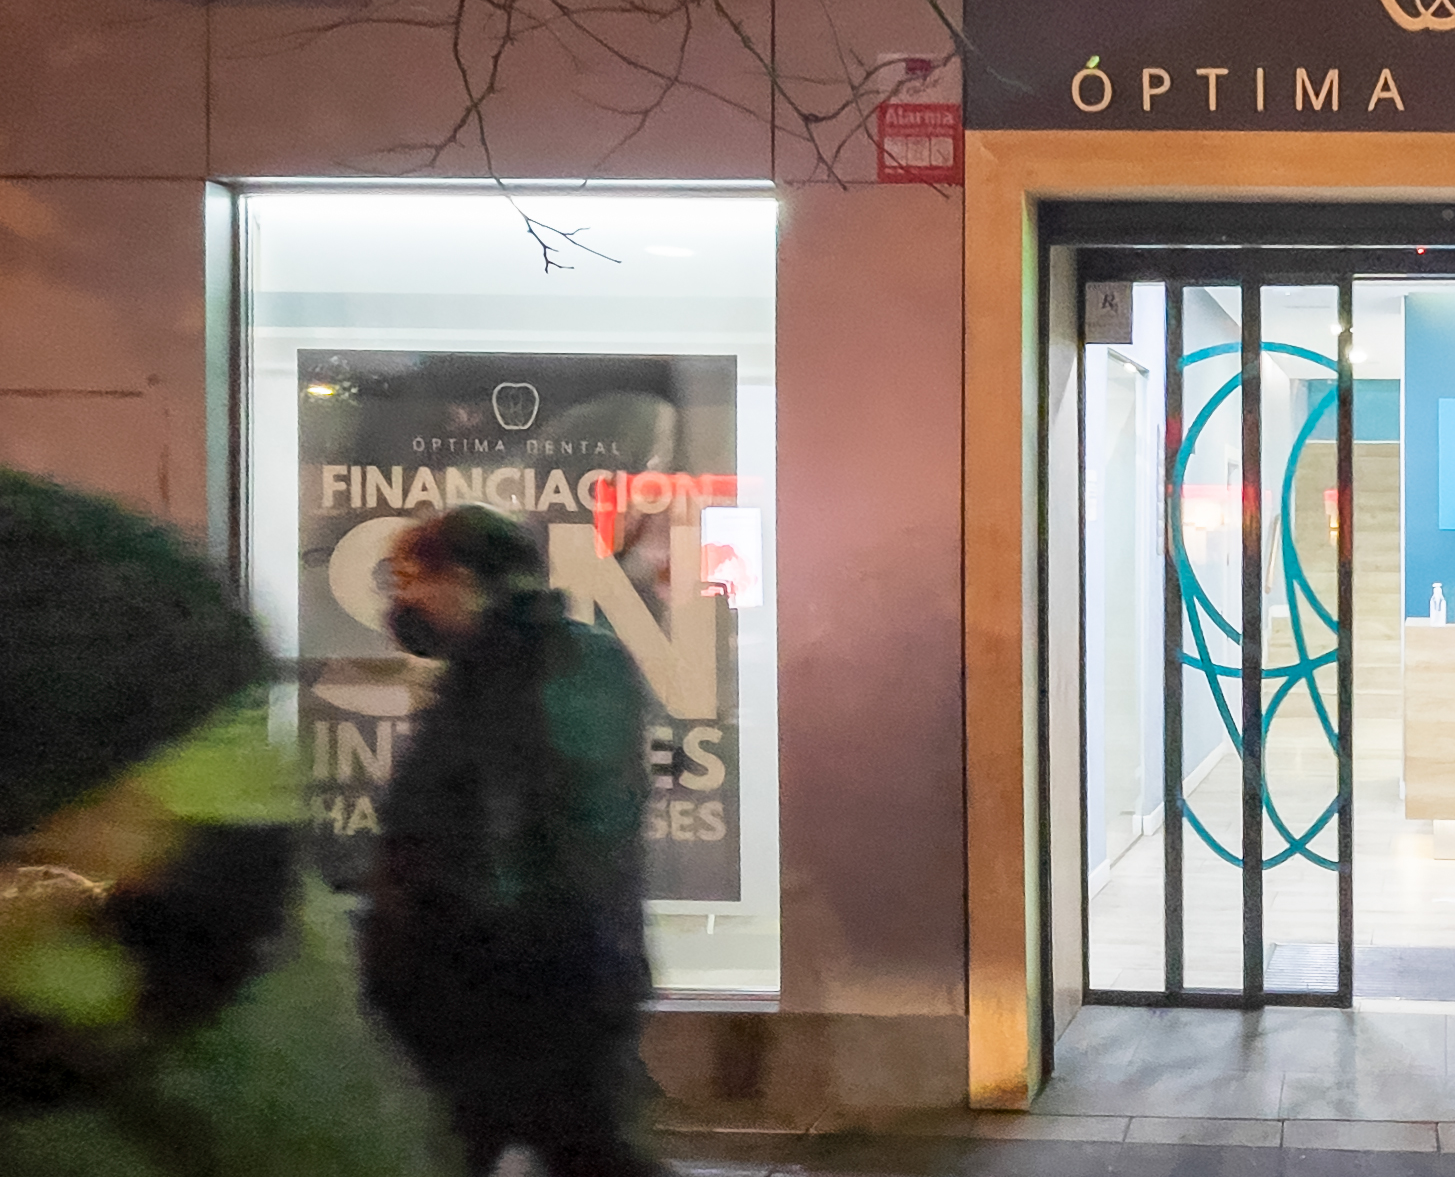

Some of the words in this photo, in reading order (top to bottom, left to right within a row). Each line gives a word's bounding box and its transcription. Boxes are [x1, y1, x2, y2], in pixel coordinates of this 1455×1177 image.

[1071, 55, 1405, 112] ÓPTIMA
[411, 436, 506, 452] ÓPTIMA
[525, 439, 622, 455] DENTAL
[321, 455, 716, 513] FINANCIACIÓN
